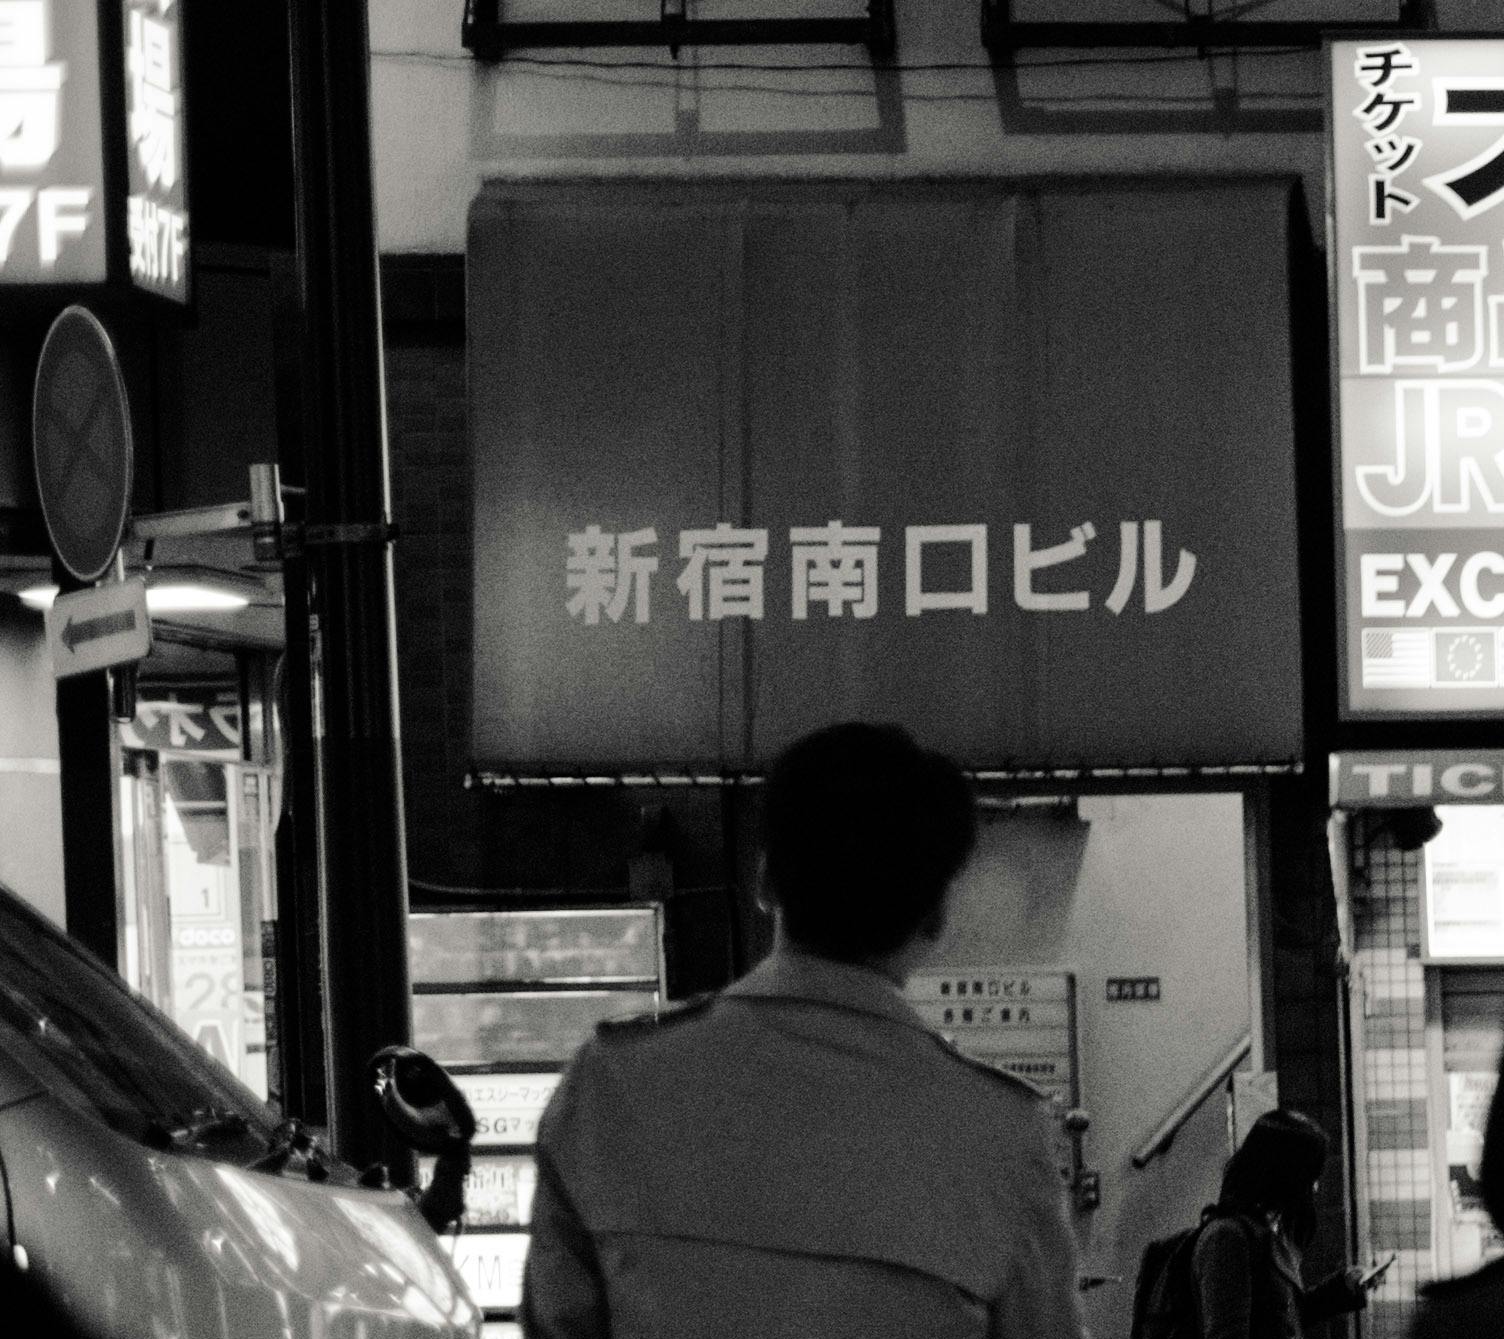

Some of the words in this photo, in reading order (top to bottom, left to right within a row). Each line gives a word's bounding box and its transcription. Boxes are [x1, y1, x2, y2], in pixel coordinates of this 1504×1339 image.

[1355, 46, 1418, 223] チケット
[565, 520, 1197, 623] 新宿南口ビル
